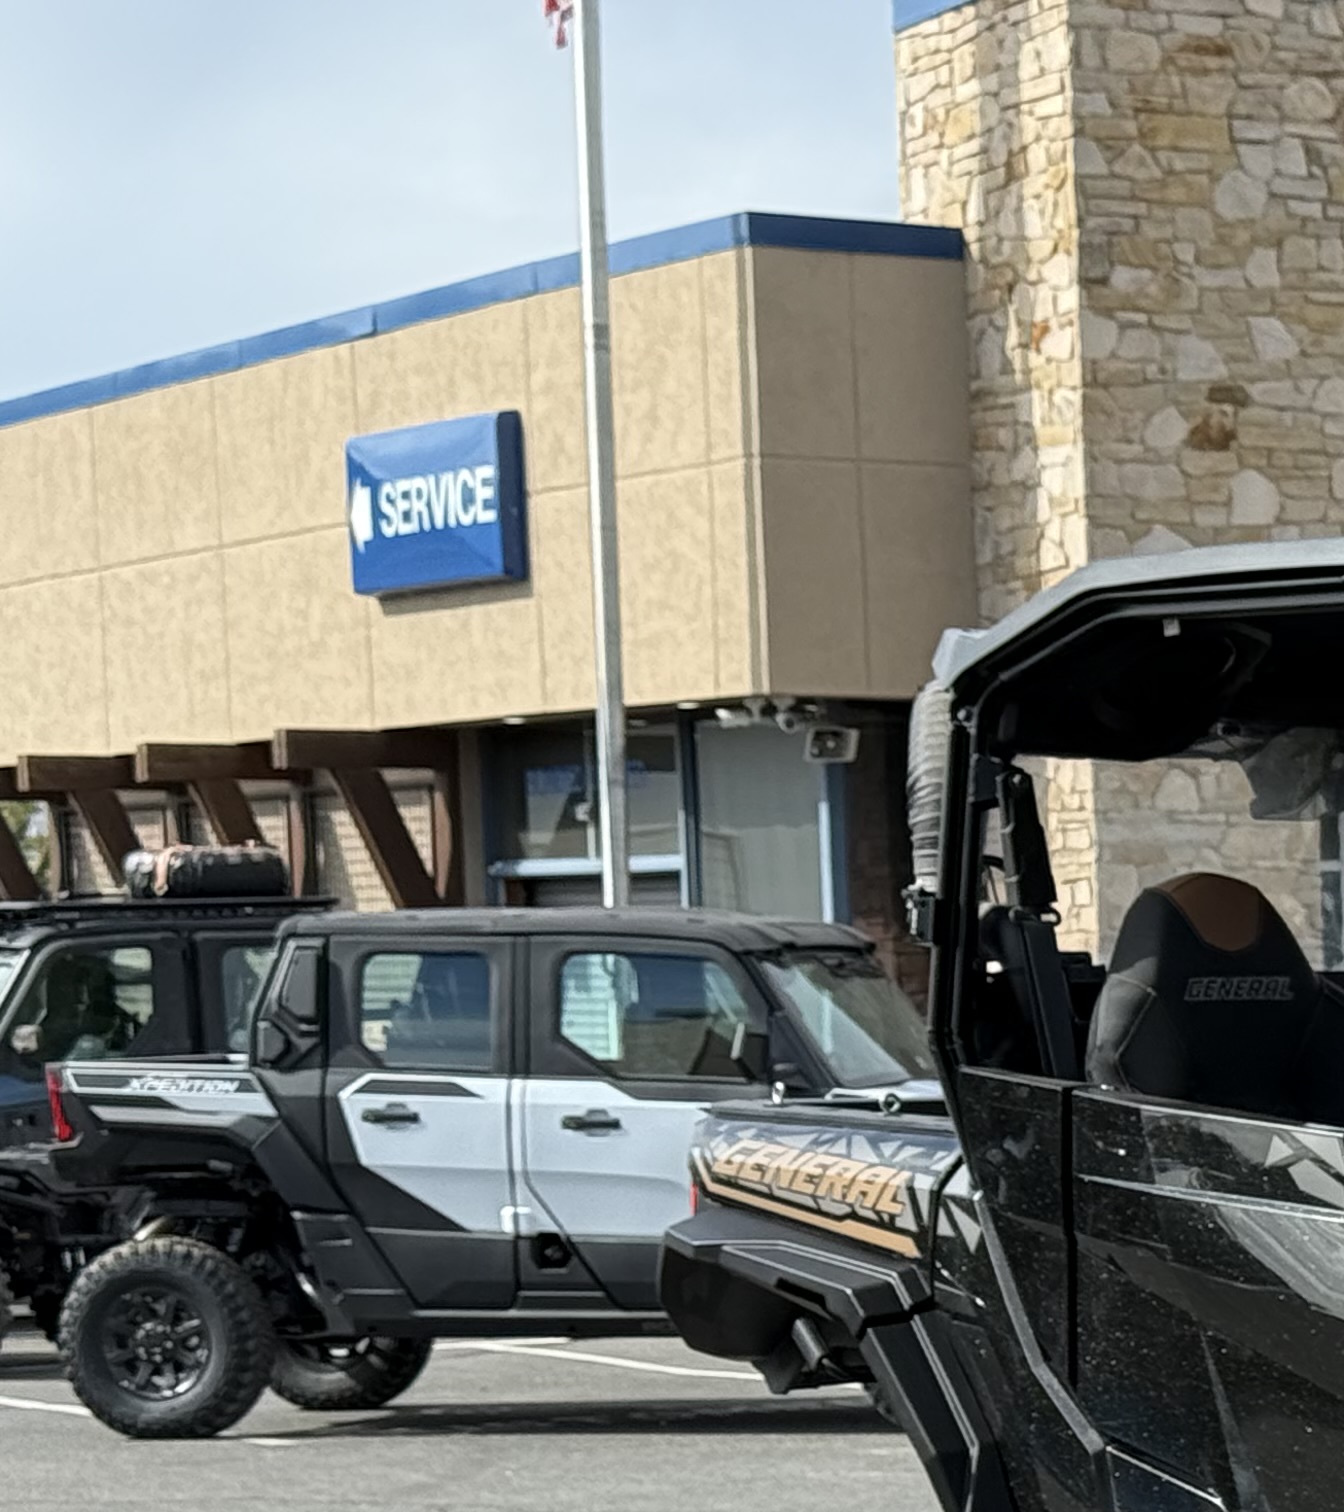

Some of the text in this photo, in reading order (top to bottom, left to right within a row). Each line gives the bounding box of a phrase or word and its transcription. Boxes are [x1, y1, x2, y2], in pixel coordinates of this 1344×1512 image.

[377, 463, 499, 539] SERVICE
[1183, 976, 1296, 1002] GENERAL
[712, 1138, 913, 1217] GENERAL
